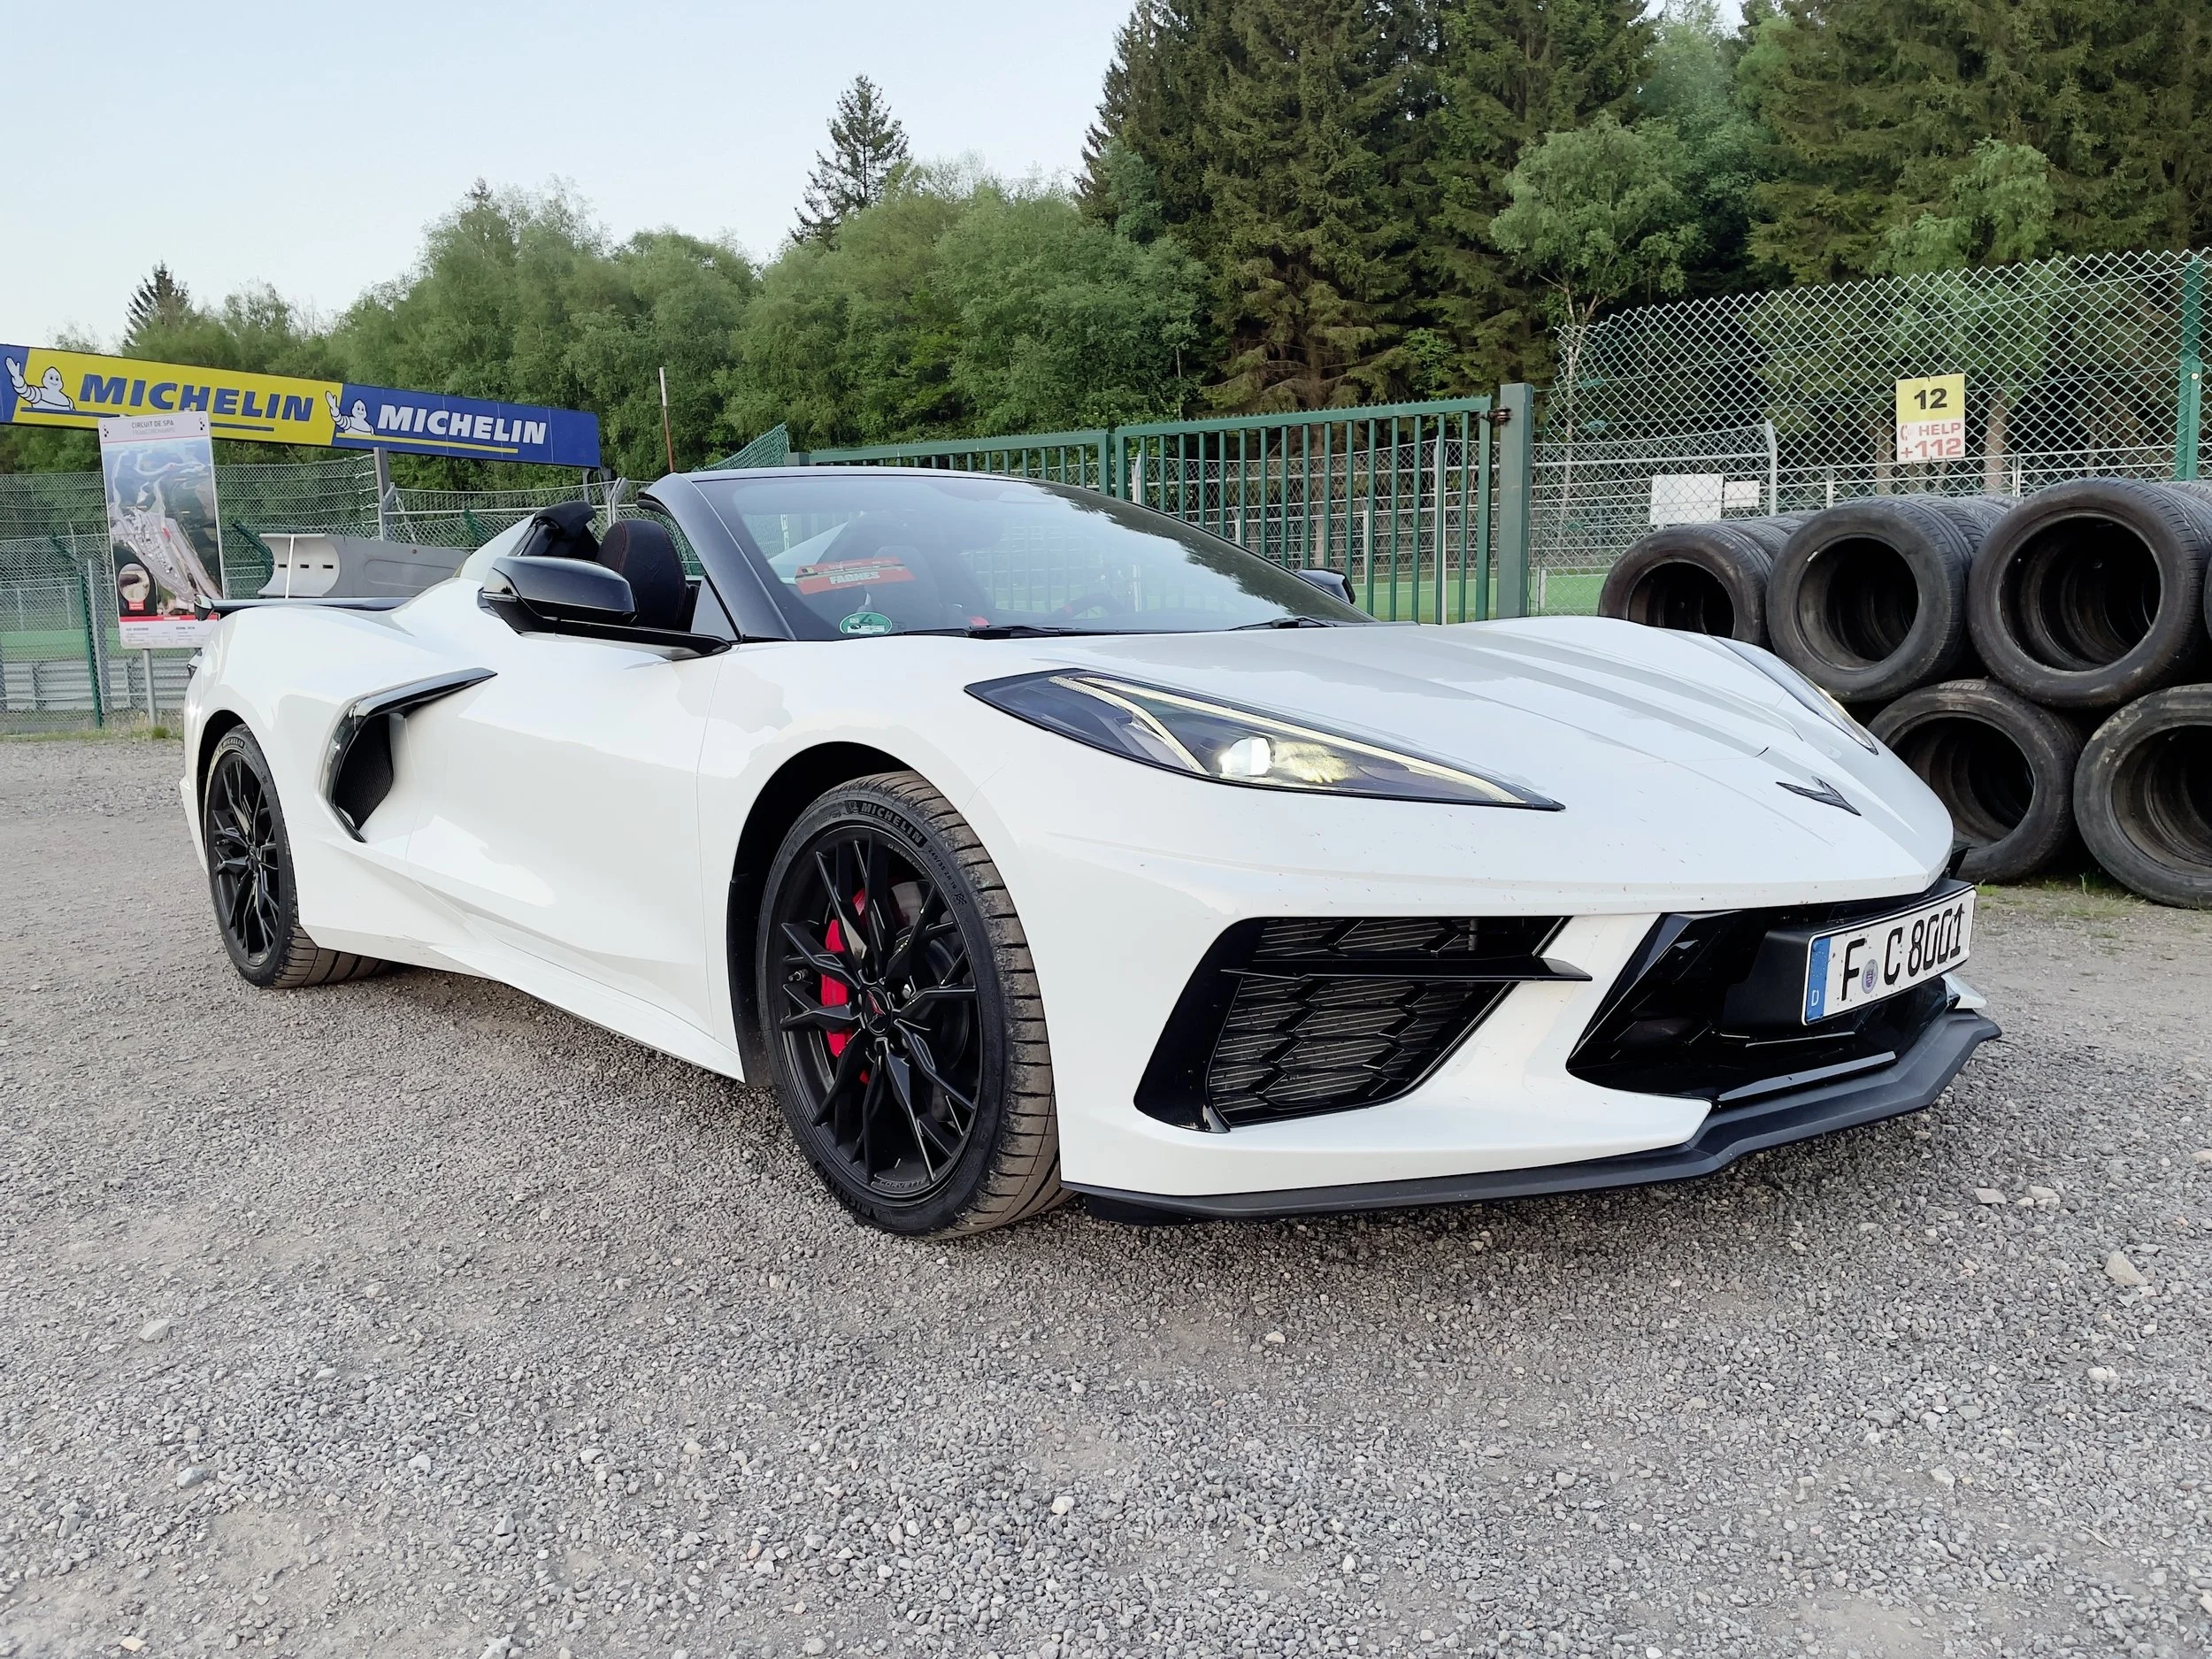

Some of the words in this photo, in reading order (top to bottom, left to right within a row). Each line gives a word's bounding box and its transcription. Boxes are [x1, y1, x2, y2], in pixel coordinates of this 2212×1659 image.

[79, 373, 314, 422] MICHELIN
[1914, 388, 1947, 410] 12
[377, 404, 547, 444] MICHELIN
[1919, 423, 1961, 436] HELP
[861, 803, 924, 843] MICHELIN
[1841, 938, 1865, 1001] F
[1884, 927, 1902, 985] C
[1908, 902, 1963, 977] 8001
[1811, 989, 1820, 1007] D
